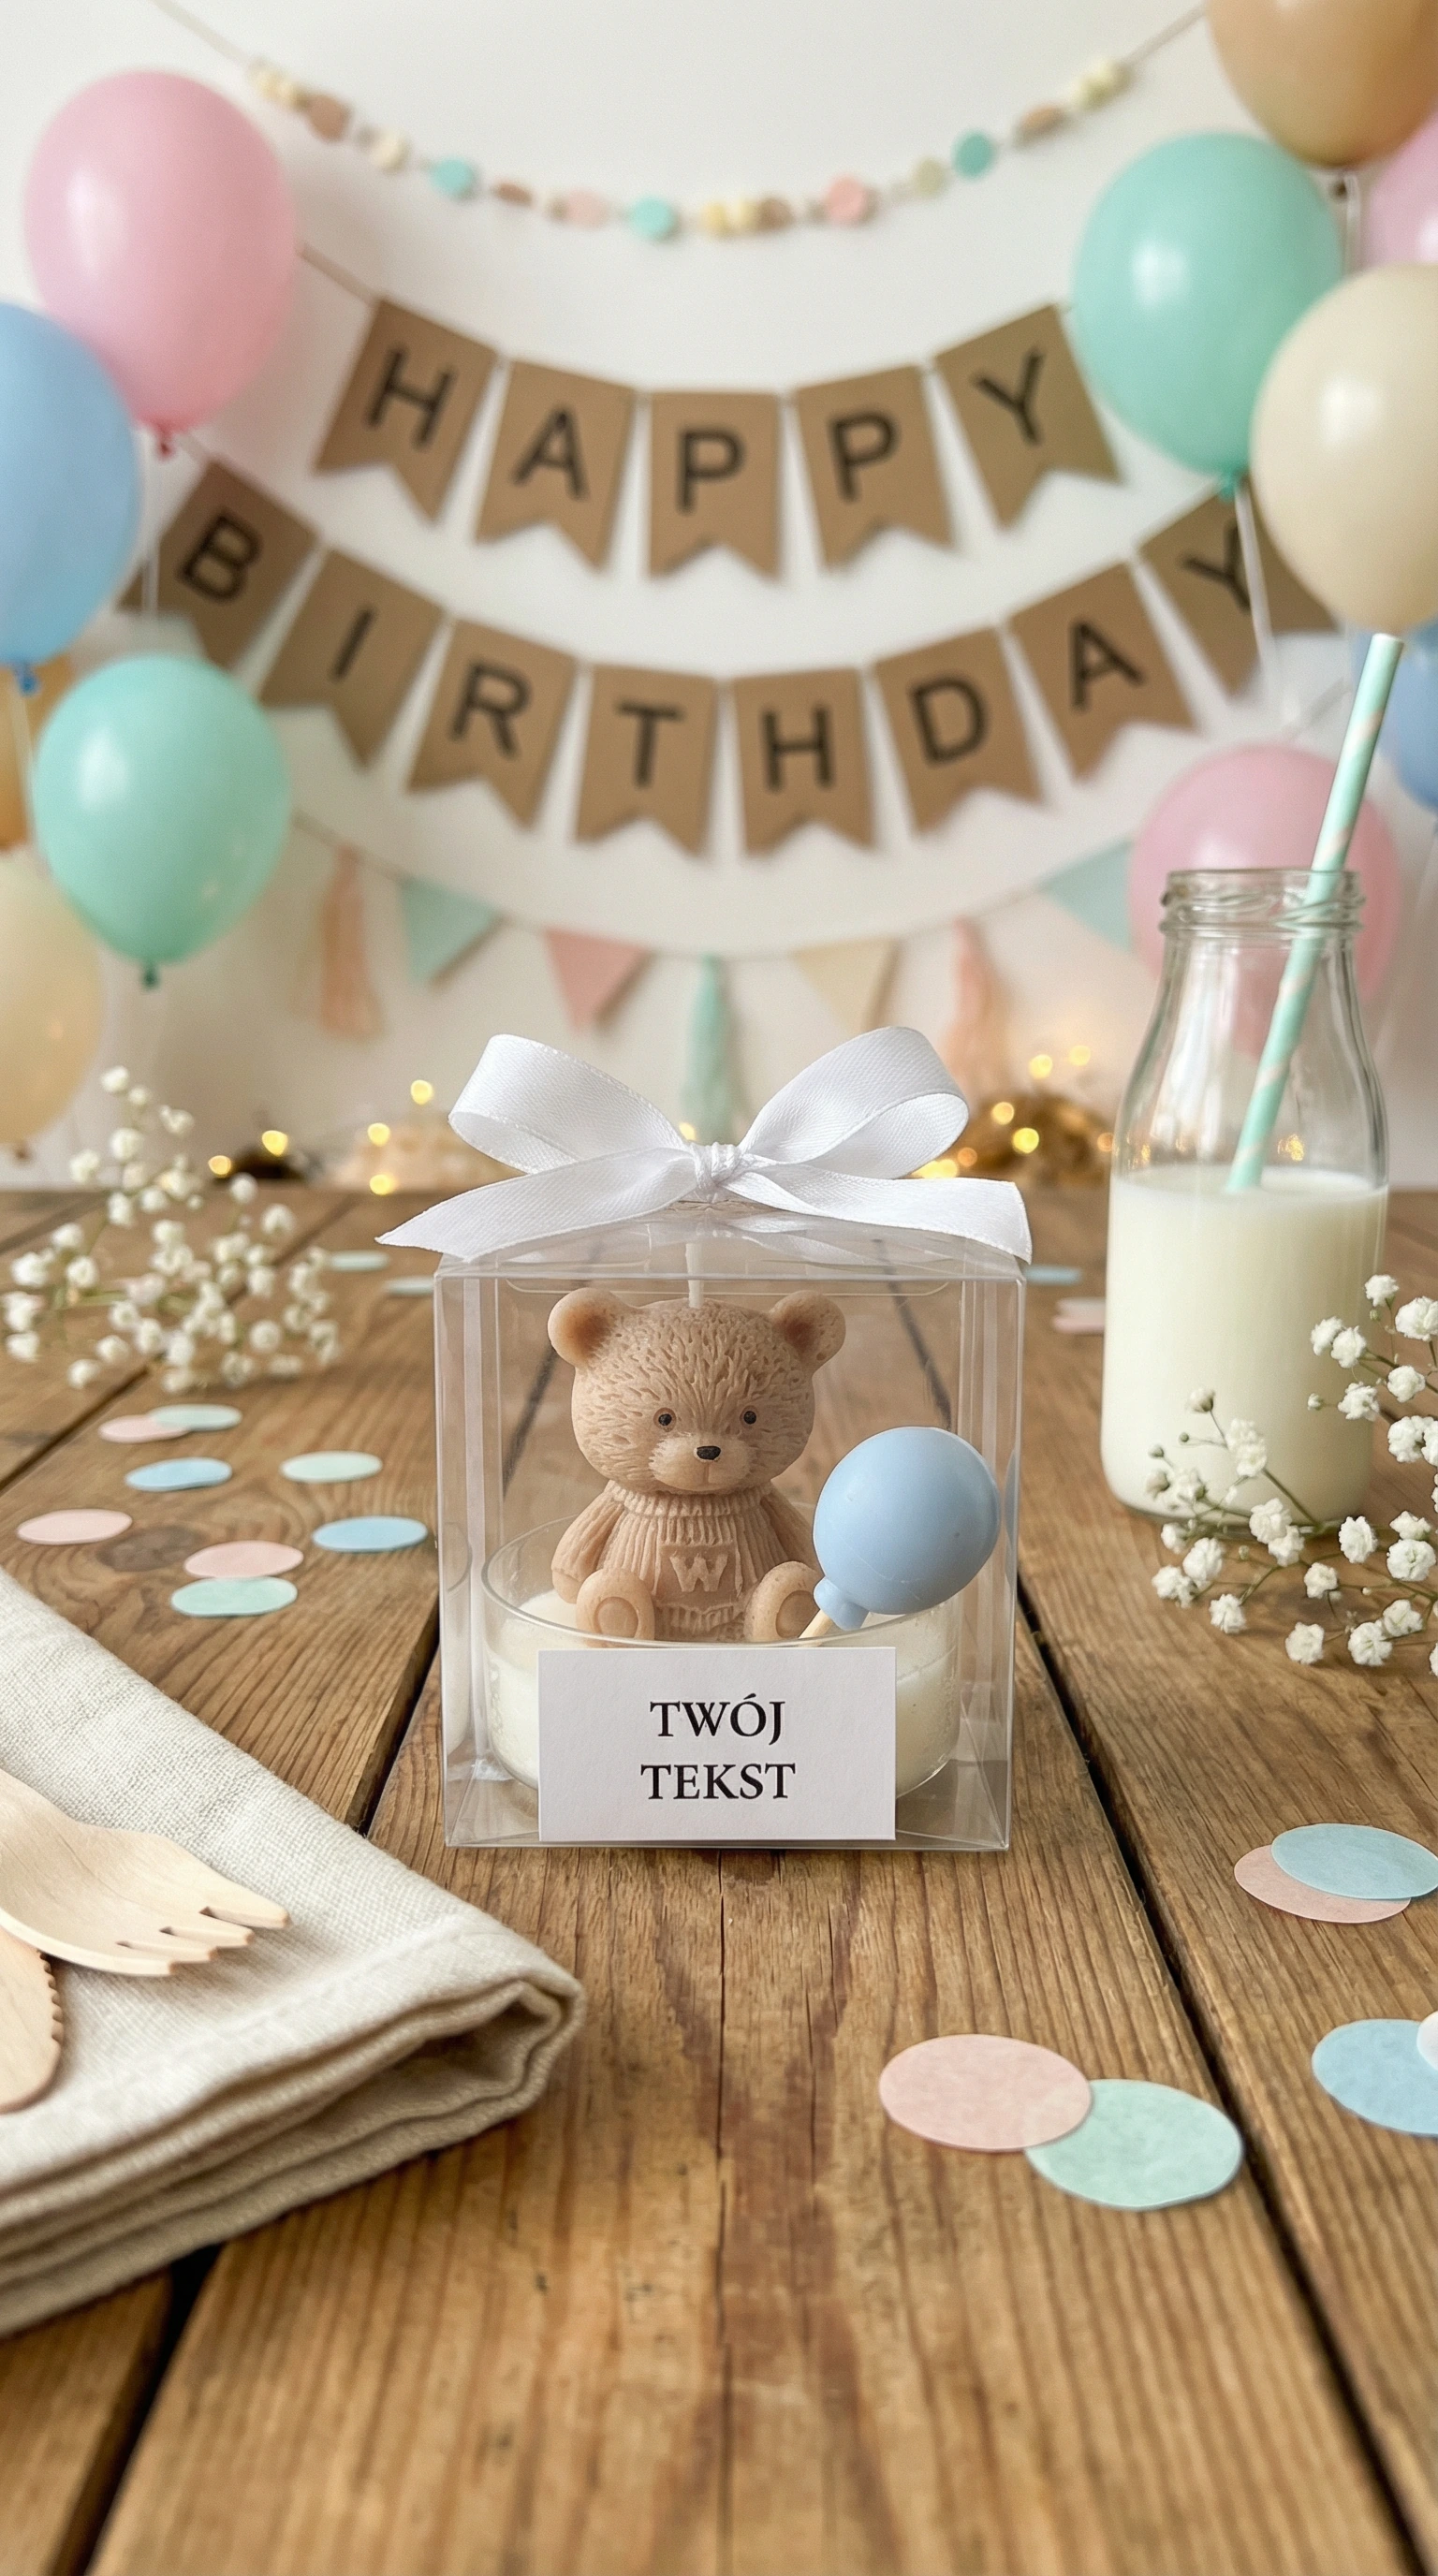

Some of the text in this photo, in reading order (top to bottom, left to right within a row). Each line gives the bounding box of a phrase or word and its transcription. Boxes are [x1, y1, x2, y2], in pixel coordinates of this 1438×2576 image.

[362, 343, 1049, 514] HAPPY
[178, 510, 1252, 791] BIRTHDAY
[650, 1692, 785, 1746] TWÓJ
[639, 1762, 796, 1800] TEKST
